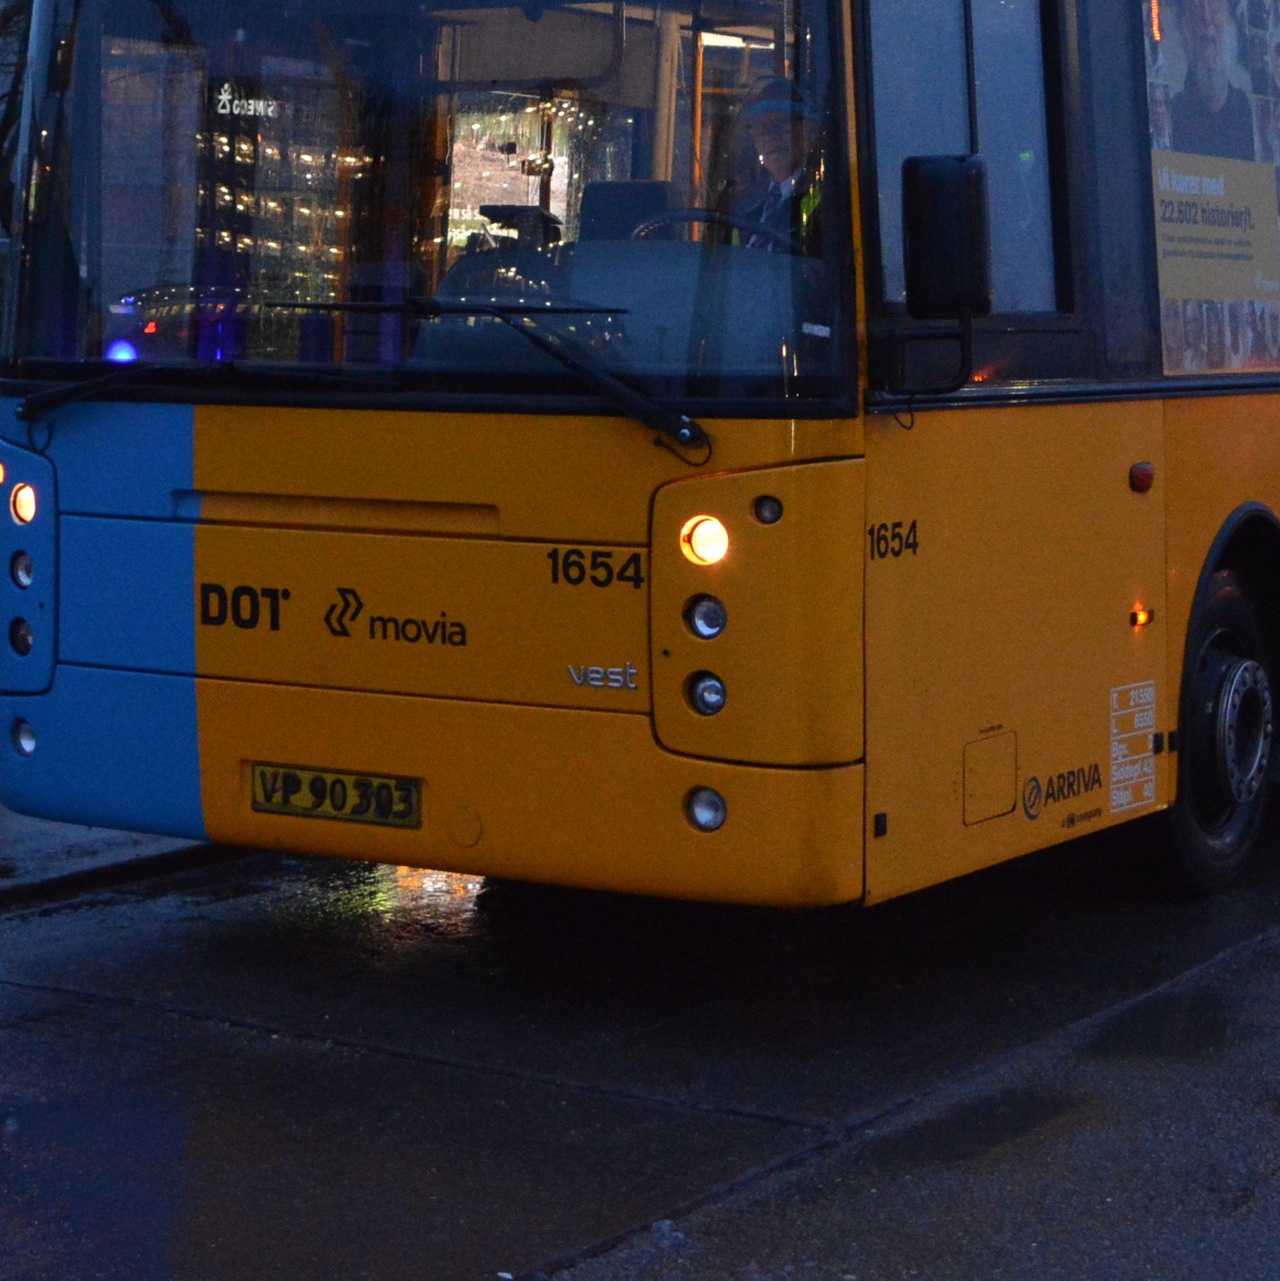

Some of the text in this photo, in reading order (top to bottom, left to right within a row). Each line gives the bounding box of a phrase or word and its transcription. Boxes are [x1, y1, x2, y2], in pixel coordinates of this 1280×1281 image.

[867, 519, 919, 561] 1654
[545, 547, 646, 590] 1654
[200, 583, 291, 631] DOT
[368, 610, 468, 647] movia
[566, 662, 639, 690] vest
[259, 769, 302, 806] VP
[309, 774, 348, 812] 90
[1043, 762, 1103, 807] ARRIVA
